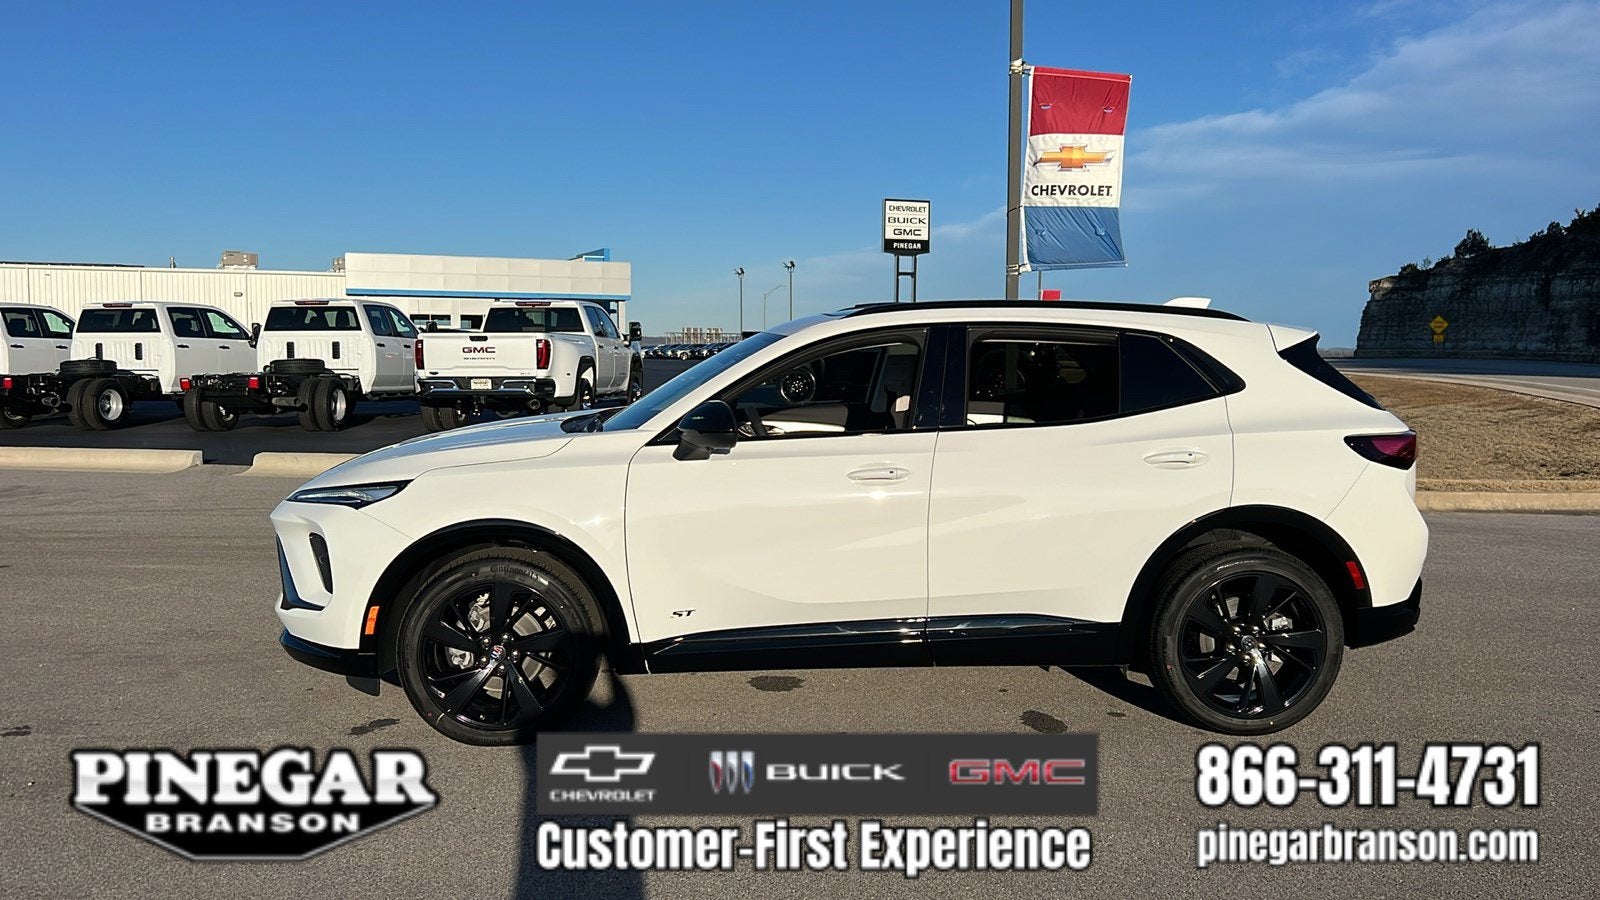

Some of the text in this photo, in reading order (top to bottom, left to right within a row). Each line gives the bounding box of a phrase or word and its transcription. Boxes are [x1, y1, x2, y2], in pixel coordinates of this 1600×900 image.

[1031, 184, 1113, 197] CHEVROLET
[888, 205, 927, 213] CHEVROLET
[888, 216, 926, 225] BUICK
[893, 228, 922, 236] GMC
[462, 346, 496, 354] GMC
[670, 608, 697, 618] ST
